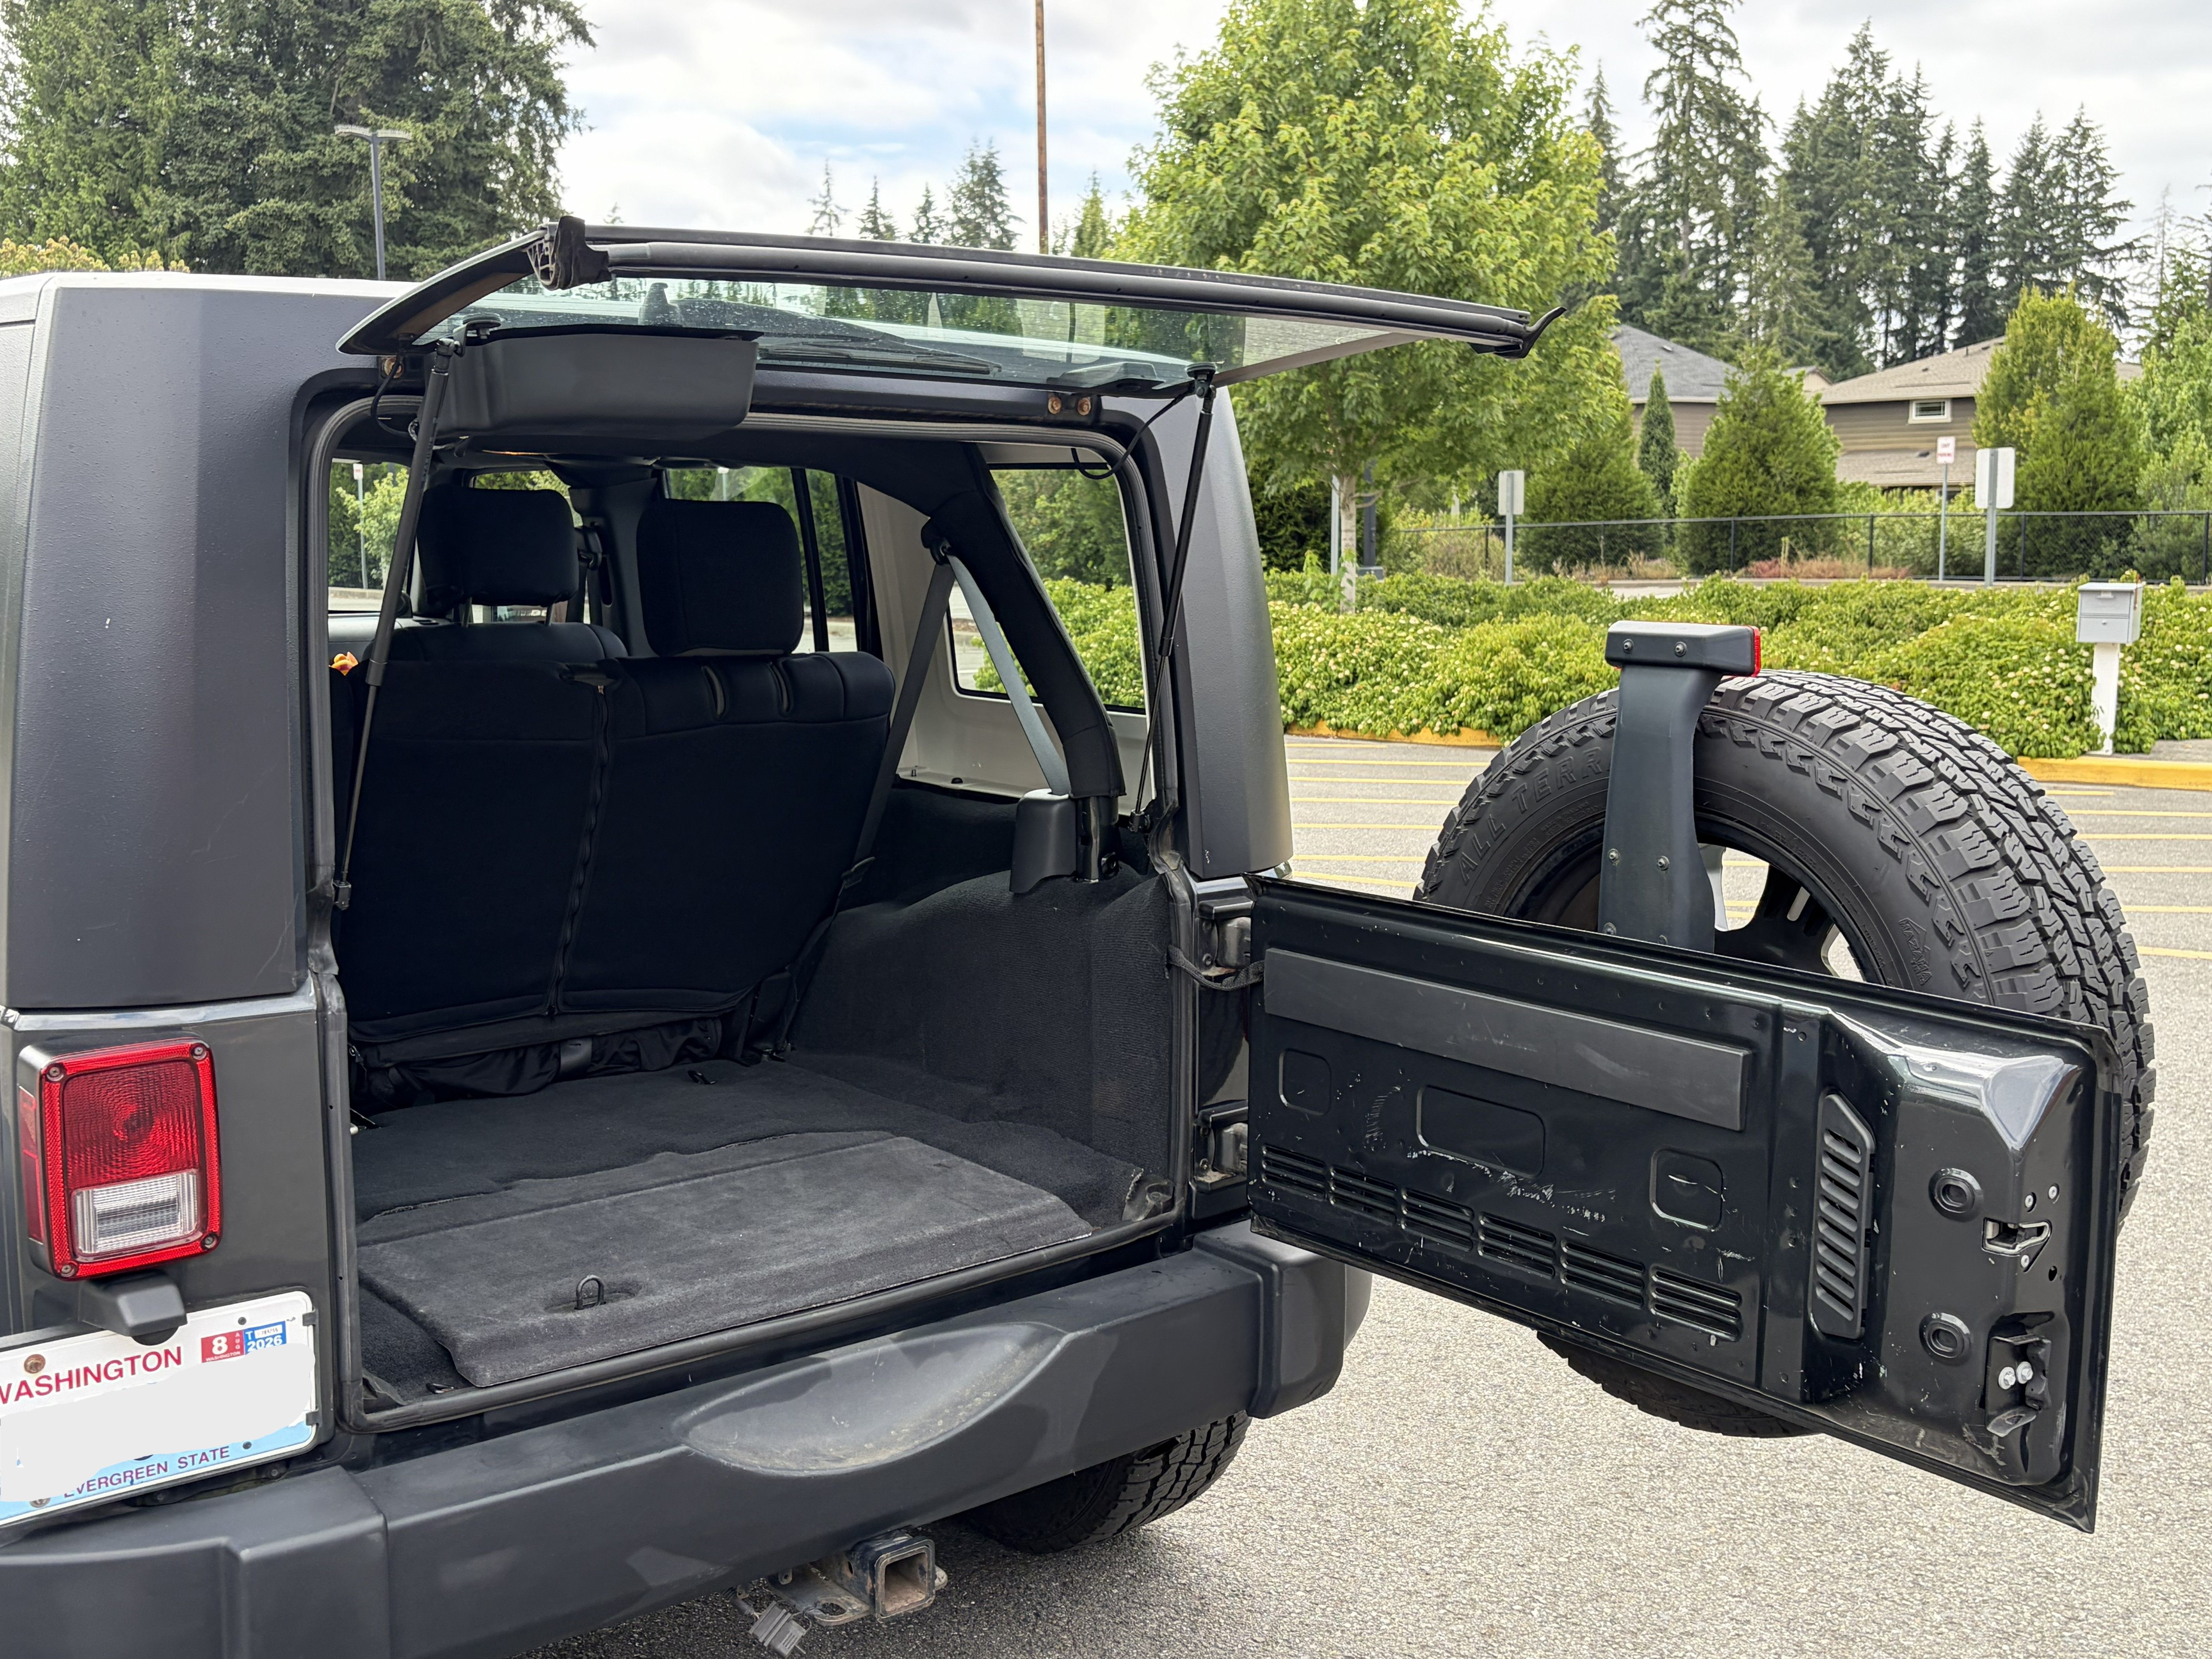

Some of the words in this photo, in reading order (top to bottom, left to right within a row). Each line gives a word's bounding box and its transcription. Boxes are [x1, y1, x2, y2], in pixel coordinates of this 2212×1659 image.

[1458, 814, 1506, 886] ALL
[1511, 747, 1610, 814] TERR
[1899, 920, 1932, 985] MAZAMA
[212, 1336, 228, 1355] 8
[247, 1335, 283, 1352] 2026
[177, 1446, 230, 1468] STATE
